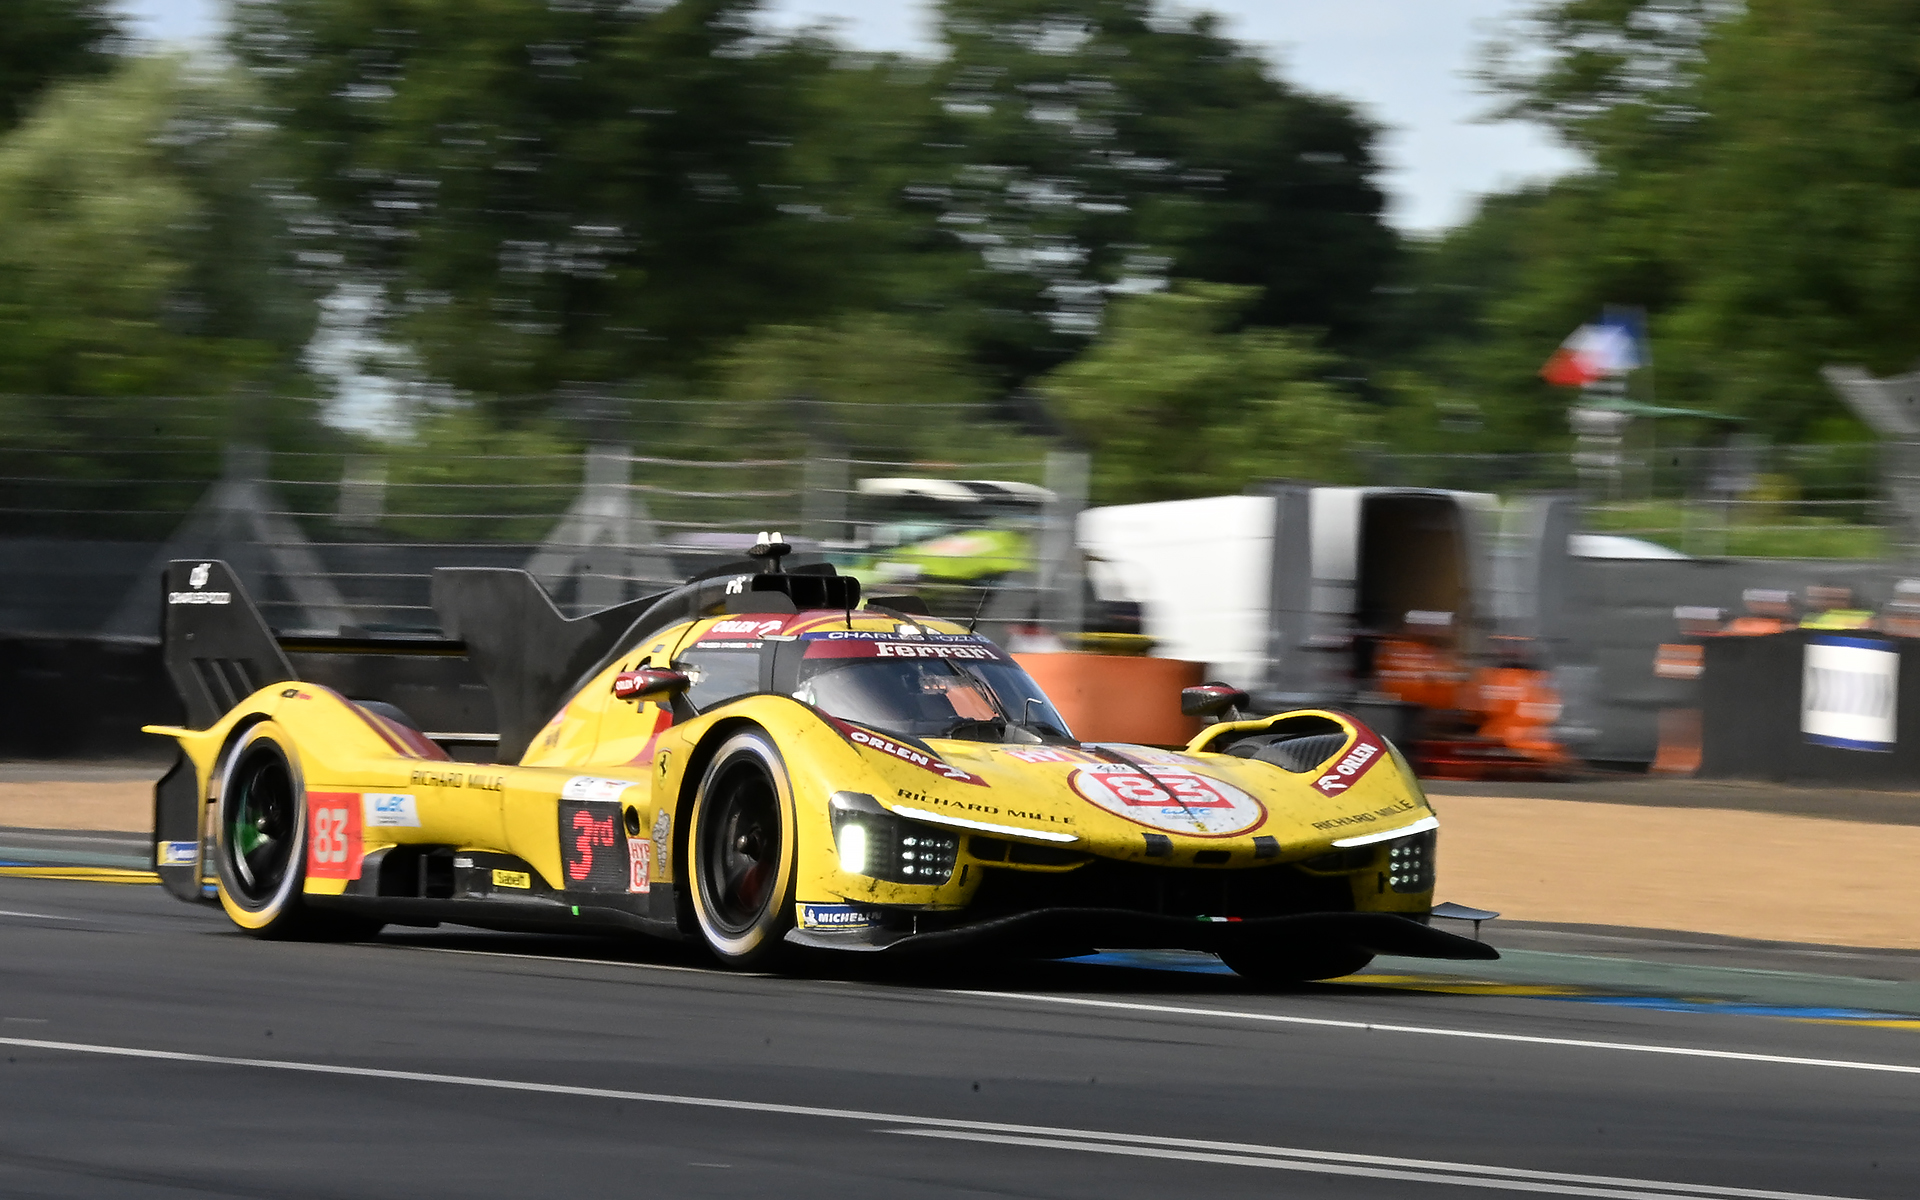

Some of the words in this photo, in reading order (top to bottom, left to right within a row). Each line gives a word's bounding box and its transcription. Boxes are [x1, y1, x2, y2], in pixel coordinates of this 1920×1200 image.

[828, 632, 925, 641] CHARLES
[874, 642, 1000, 661] Ferrari
[850, 732, 929, 766] ORLEN
[1336, 743, 1378, 776] ORLEN
[1105, 776, 1219, 803] 83
[898, 789, 999, 814] RICHARD
[1007, 809, 1077, 826] MILLE
[1311, 812, 1376, 831] RICHARD
[1374, 799, 1415, 817] MILLE
[314, 807, 348, 863] 83
[569, 810, 614, 880] 3rd
[817, 911, 882, 923] MICHELIN
